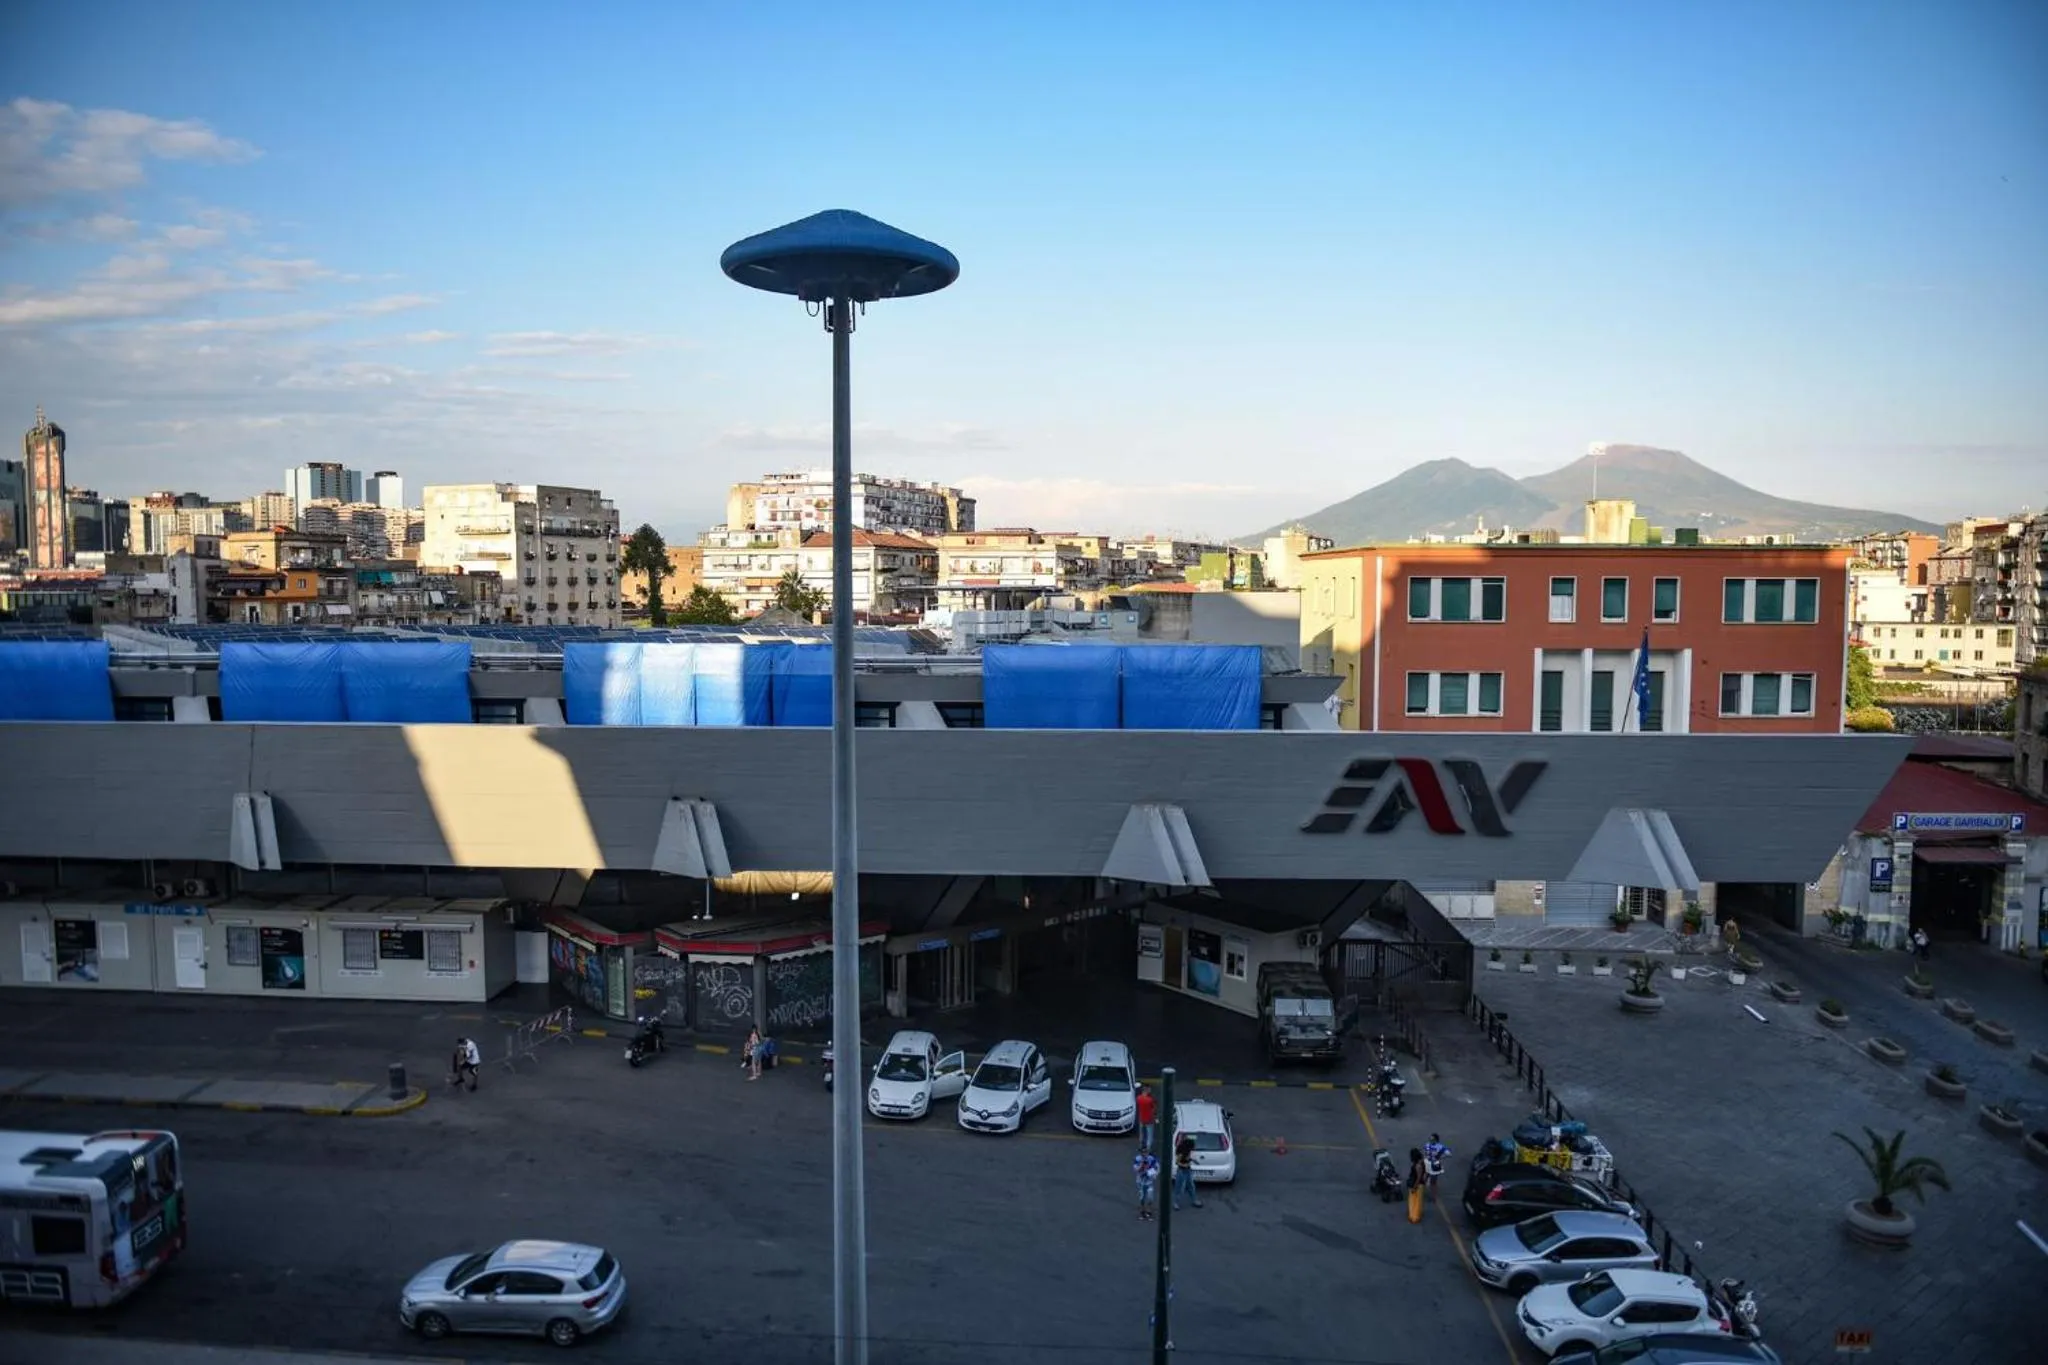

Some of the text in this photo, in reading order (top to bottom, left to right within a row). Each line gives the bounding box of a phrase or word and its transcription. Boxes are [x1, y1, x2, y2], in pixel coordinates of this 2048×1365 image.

[1301, 760, 1548, 836] EAV
[1895, 815, 2022, 828] P GARAGE GARIBALDI P
[1875, 861, 1889, 877] P
[1838, 1331, 1871, 1345] TAXI
